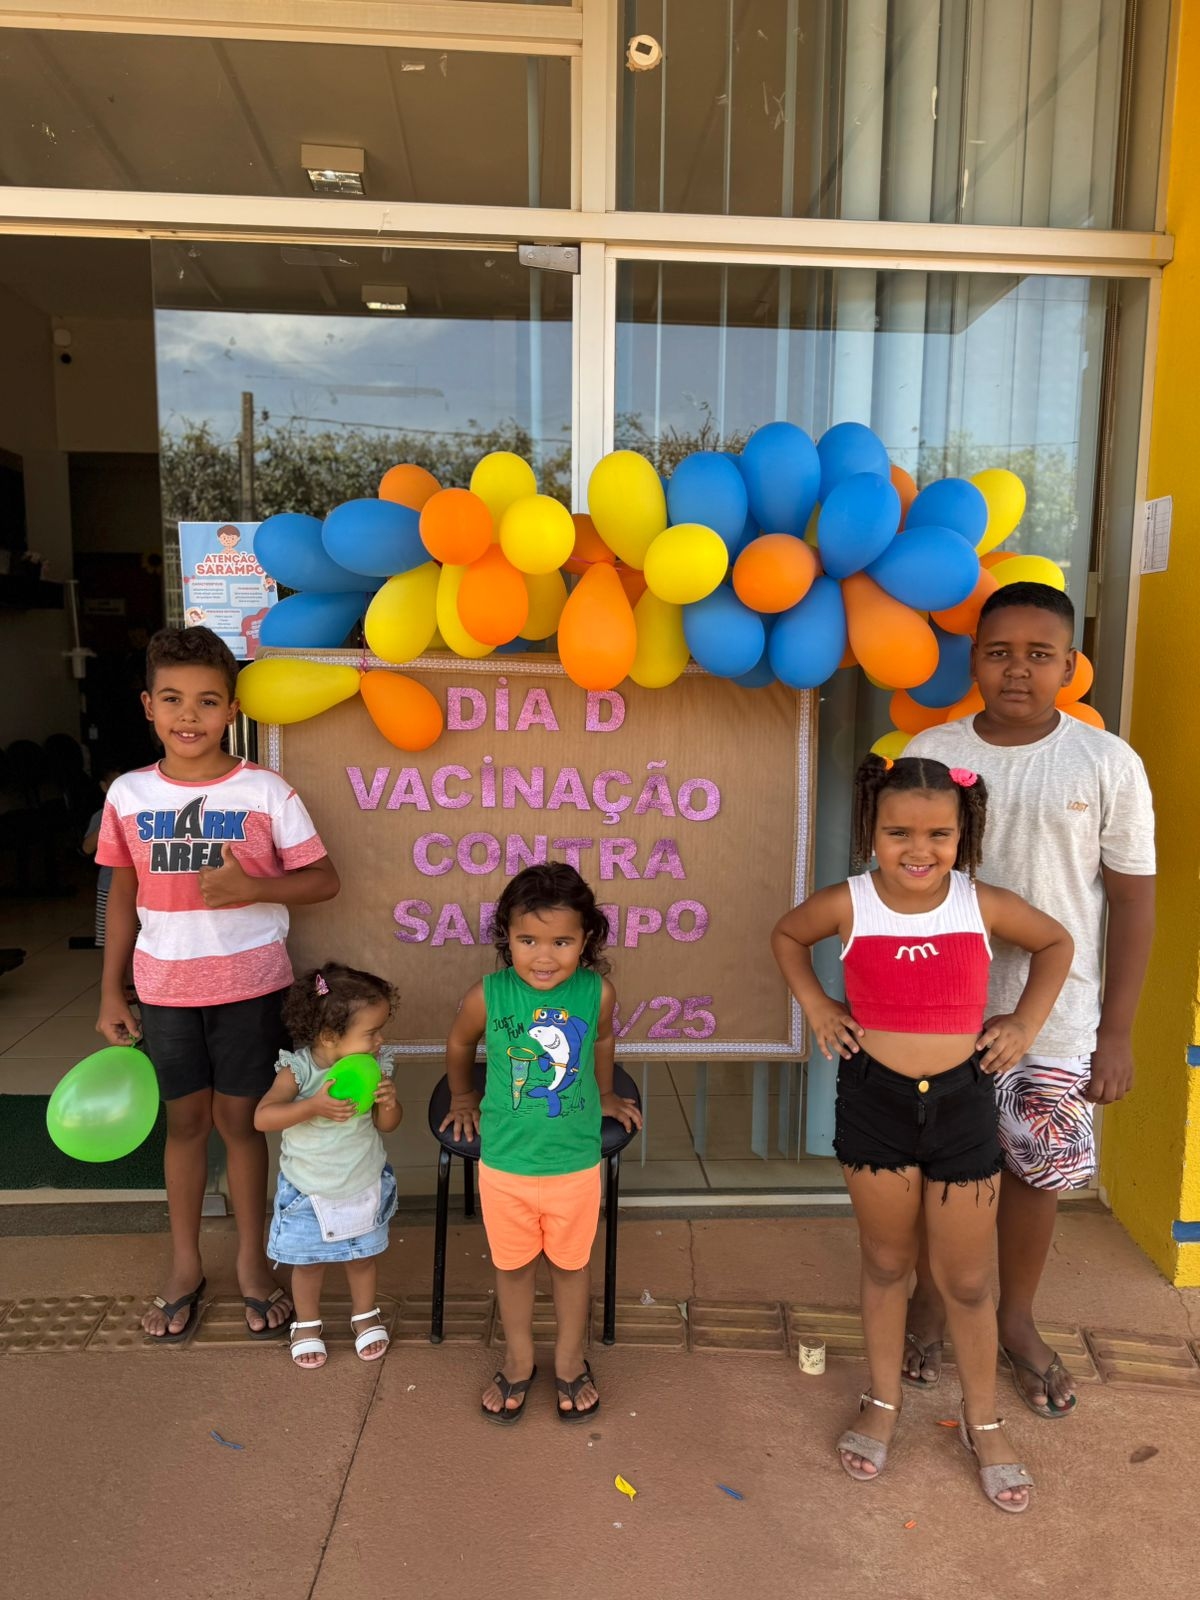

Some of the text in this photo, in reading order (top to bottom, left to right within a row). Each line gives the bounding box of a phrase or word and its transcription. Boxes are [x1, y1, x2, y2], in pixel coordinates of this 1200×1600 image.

[196, 564, 265, 575] SARAMPO
[585, 689, 626, 732] D
[136, 796, 248, 840] SHARK
[412, 831, 687, 880] CONTRA
[493, 1014, 515, 1032] JUST
[507, 1023, 525, 1041] FUN
